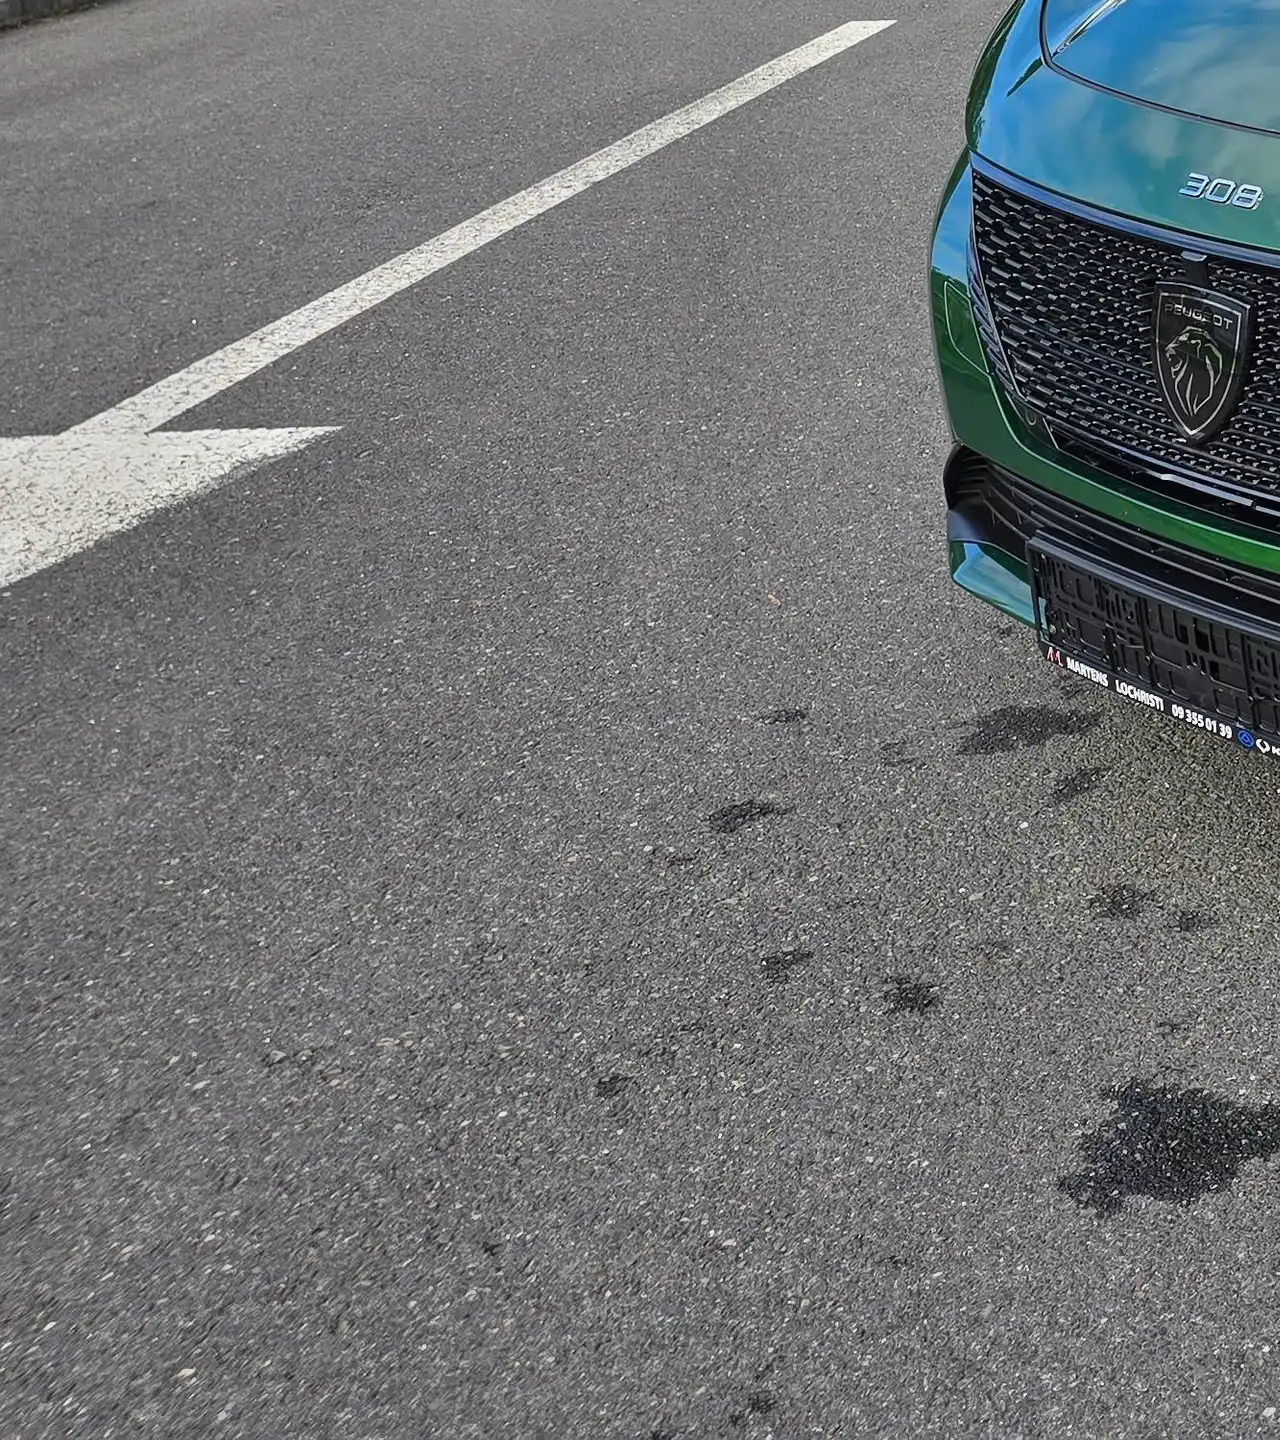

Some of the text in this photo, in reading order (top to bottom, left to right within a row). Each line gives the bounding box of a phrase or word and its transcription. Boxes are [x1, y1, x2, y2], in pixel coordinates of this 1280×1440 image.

[1179, 172, 1265, 210] 308
[1165, 303, 1233, 330] PEUGEOT
[1067, 657, 1108, 687] MARTENS
[1115, 680, 1164, 711] LOCHRISTI
[1172, 705, 1184, 719] 09
[1186, 710, 1204, 728] 355
[1206, 717, 1217, 733] 01
[1219, 724, 1232, 739] 39
